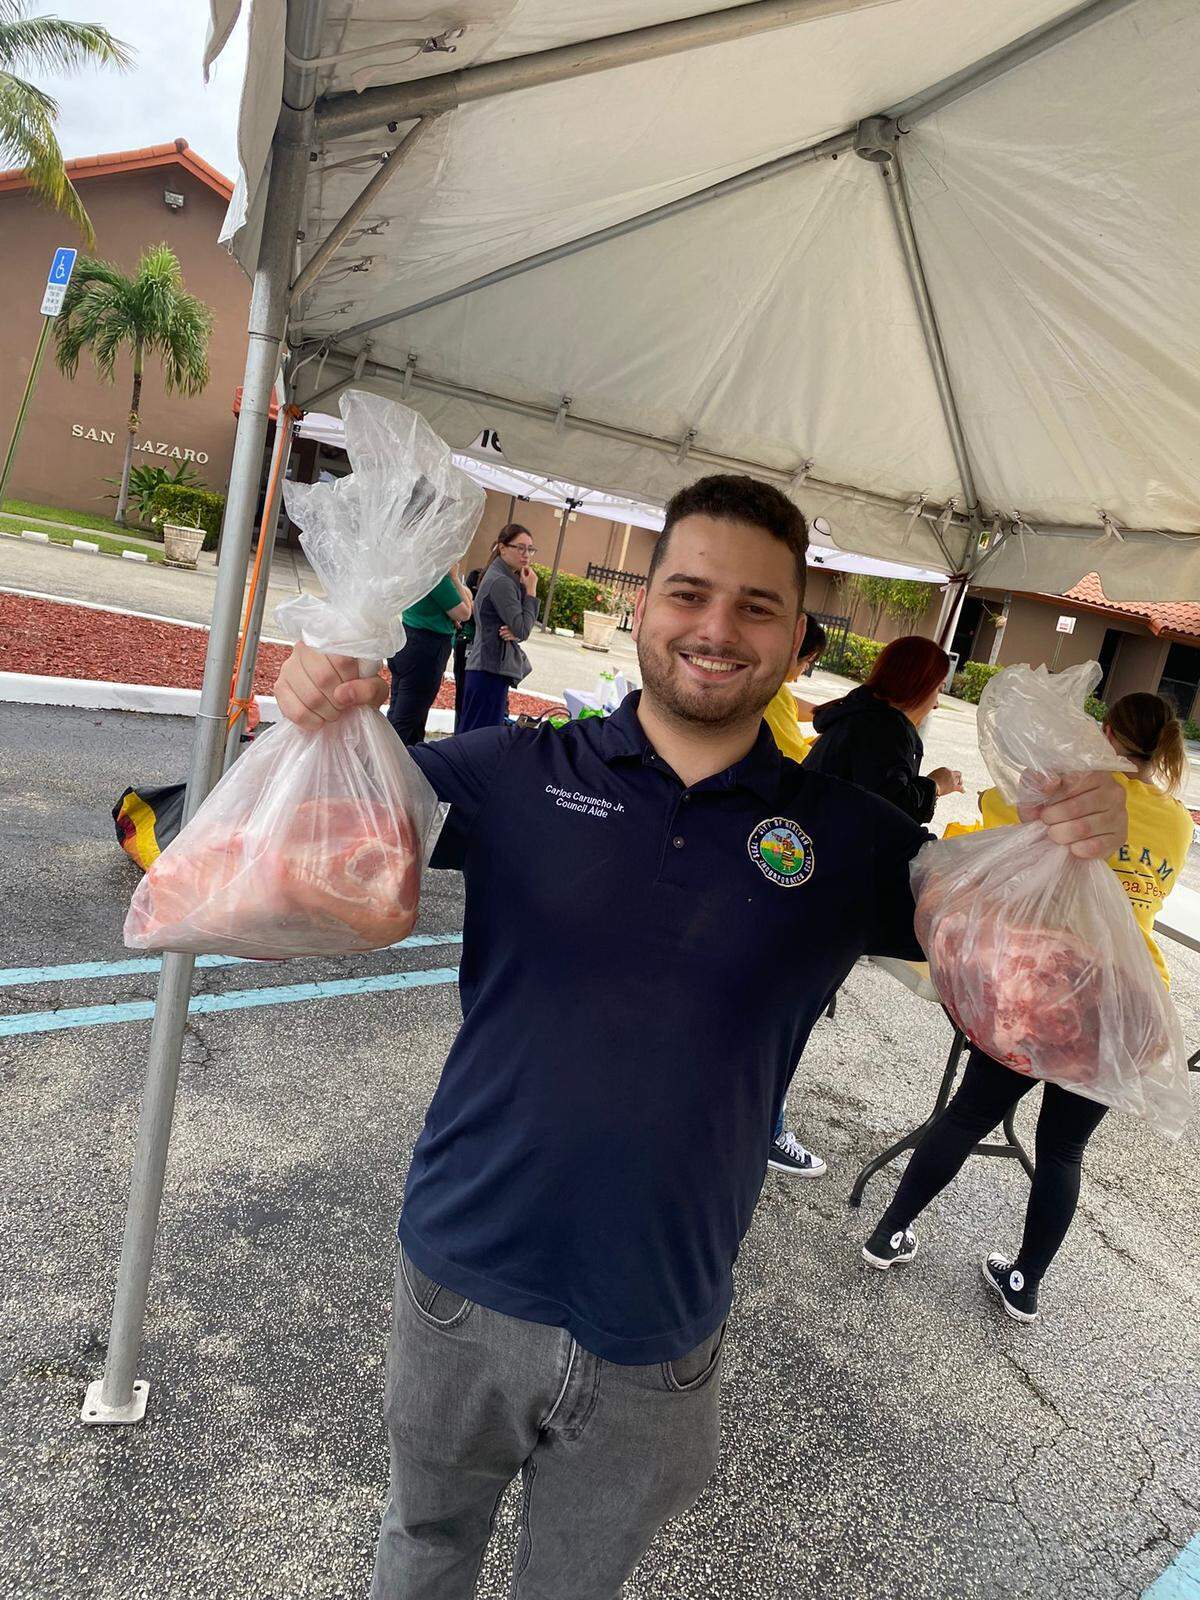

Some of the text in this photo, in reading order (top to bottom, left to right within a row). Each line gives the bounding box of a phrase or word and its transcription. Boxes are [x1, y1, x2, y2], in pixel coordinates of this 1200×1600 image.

[72, 424, 115, 444] SAN
[545, 784, 625, 812] Carlos Caruncho Jr.
[555, 797, 609, 818] Council Aide
[758, 822, 772, 835] CITY
[750, 842, 760, 858] SEAL
[1119, 844, 1174, 881] EAM
